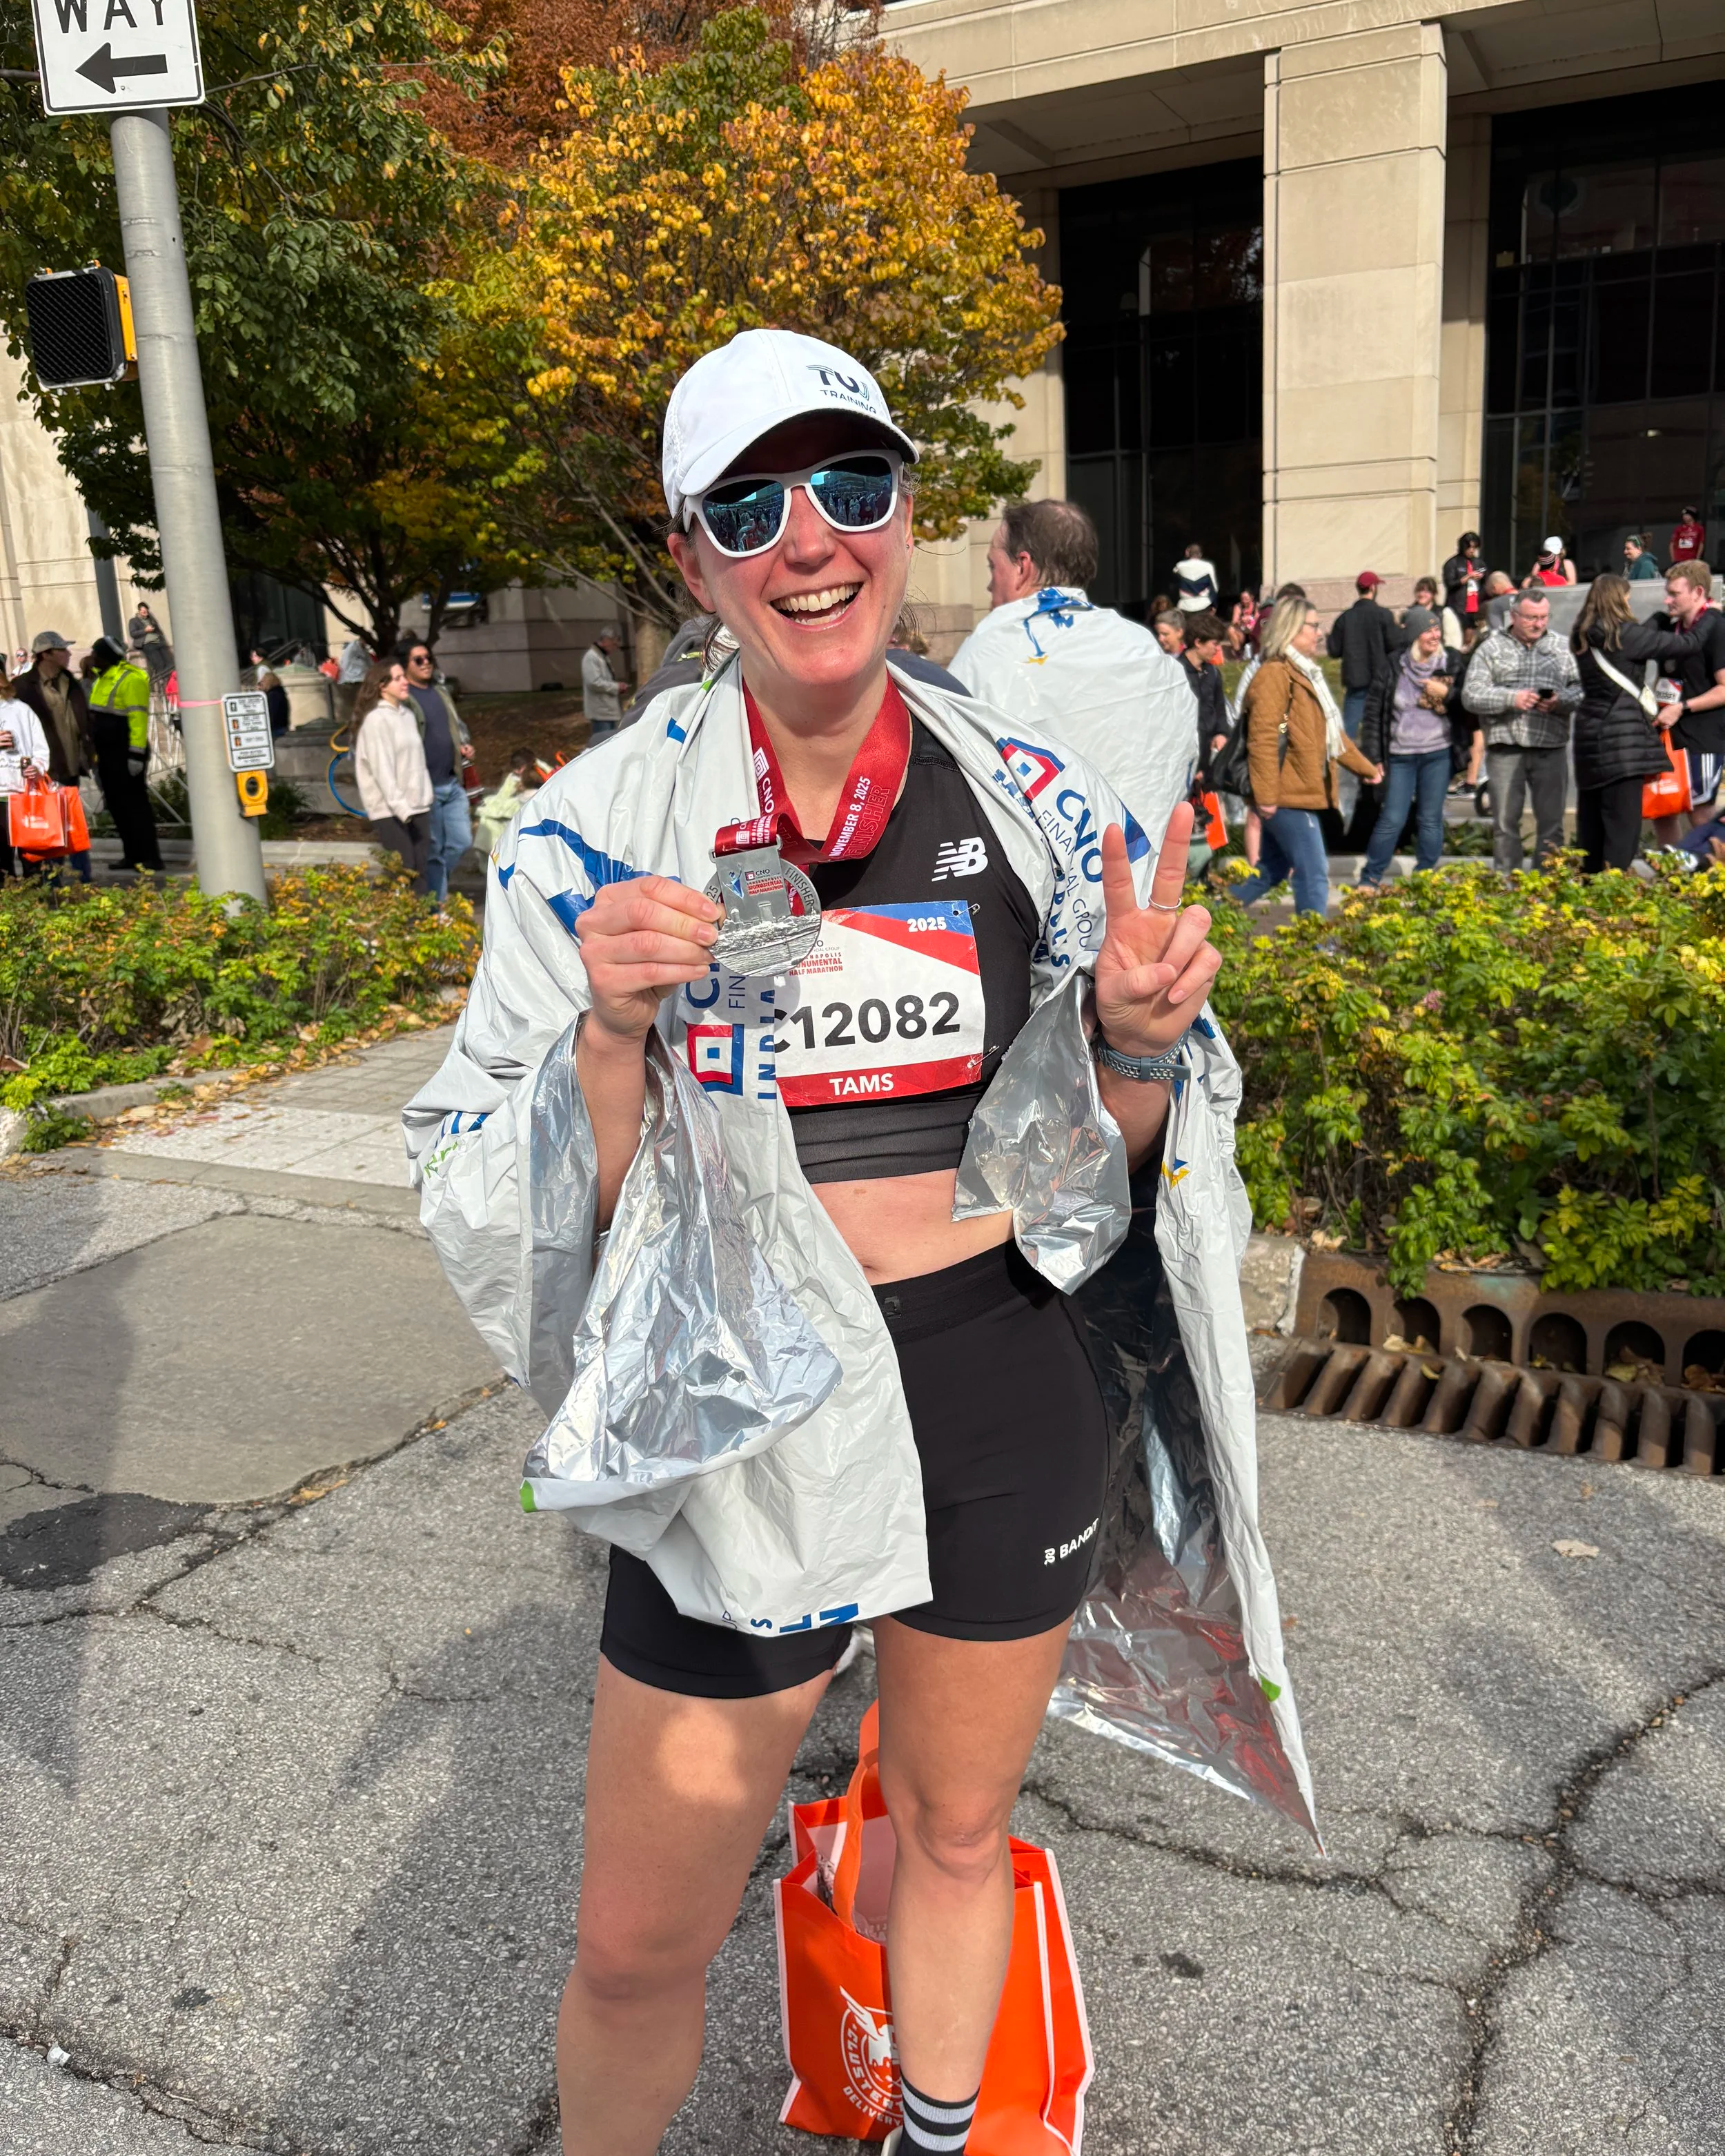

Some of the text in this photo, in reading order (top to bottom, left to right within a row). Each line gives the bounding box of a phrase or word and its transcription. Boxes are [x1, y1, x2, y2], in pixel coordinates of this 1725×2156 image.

[55, 0, 164, 33] WAY
[820, 389, 876, 414] TRAINING
[762, 777, 774, 813] CNO
[829, 813, 859, 856] NOVEMBER
[854, 776, 871, 801] 2025
[842, 785, 890, 856] FINISHER
[1056, 789, 1103, 883] CNO
[706, 885, 718, 901] 25
[785, 867, 815, 908] FINISHER
[907, 917, 947, 932] 2025
[1072, 899, 1092, 948] GROU
[806, 966, 843, 974] MARATHON
[829, 1072, 894, 1096] TAMS
[842, 2085, 902, 2126] DELIVERY
